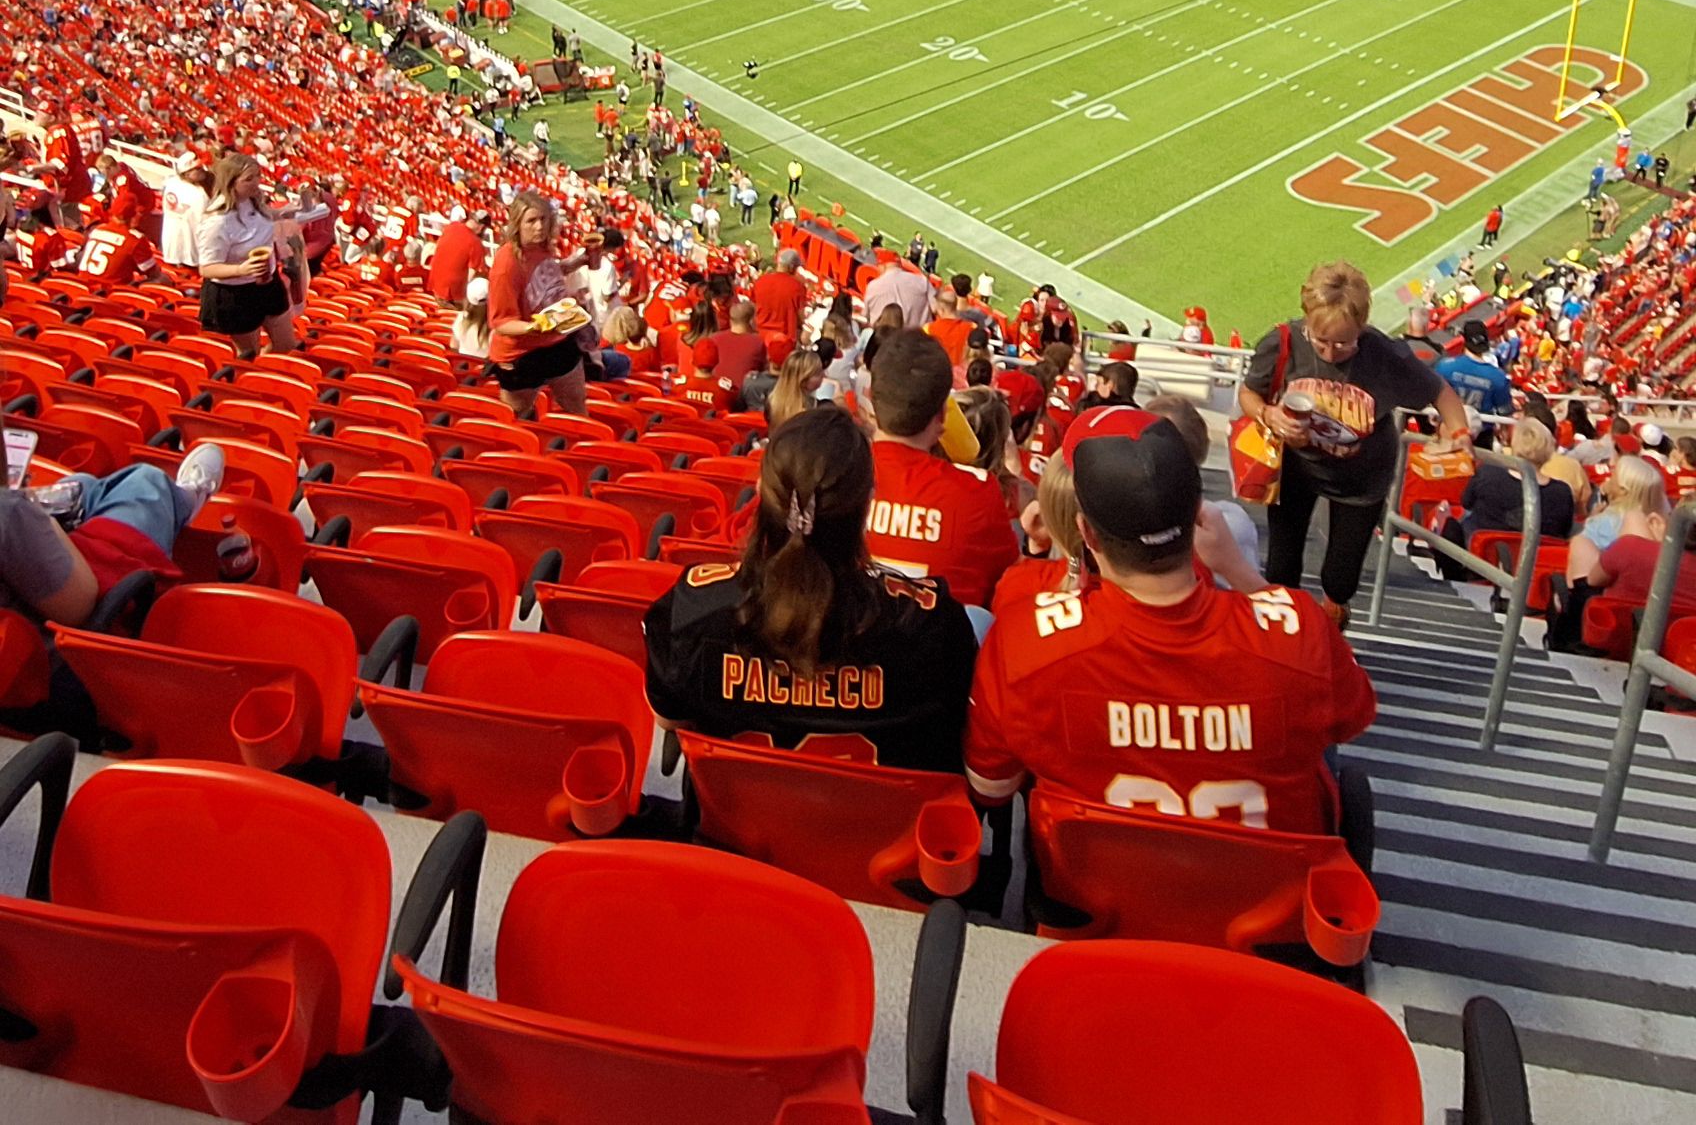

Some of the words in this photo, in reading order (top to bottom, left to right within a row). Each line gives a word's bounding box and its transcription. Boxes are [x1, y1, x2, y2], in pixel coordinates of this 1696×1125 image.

[920, 35, 979, 61] 20
[1051, 89, 1118, 120] 10
[1286, 44, 1650, 247] CHIEFS
[16, 242, 34, 270] 15
[79, 240, 116, 276] 15
[721, 652, 884, 710] PACHECO
[1107, 700, 1253, 752] BOLTON
